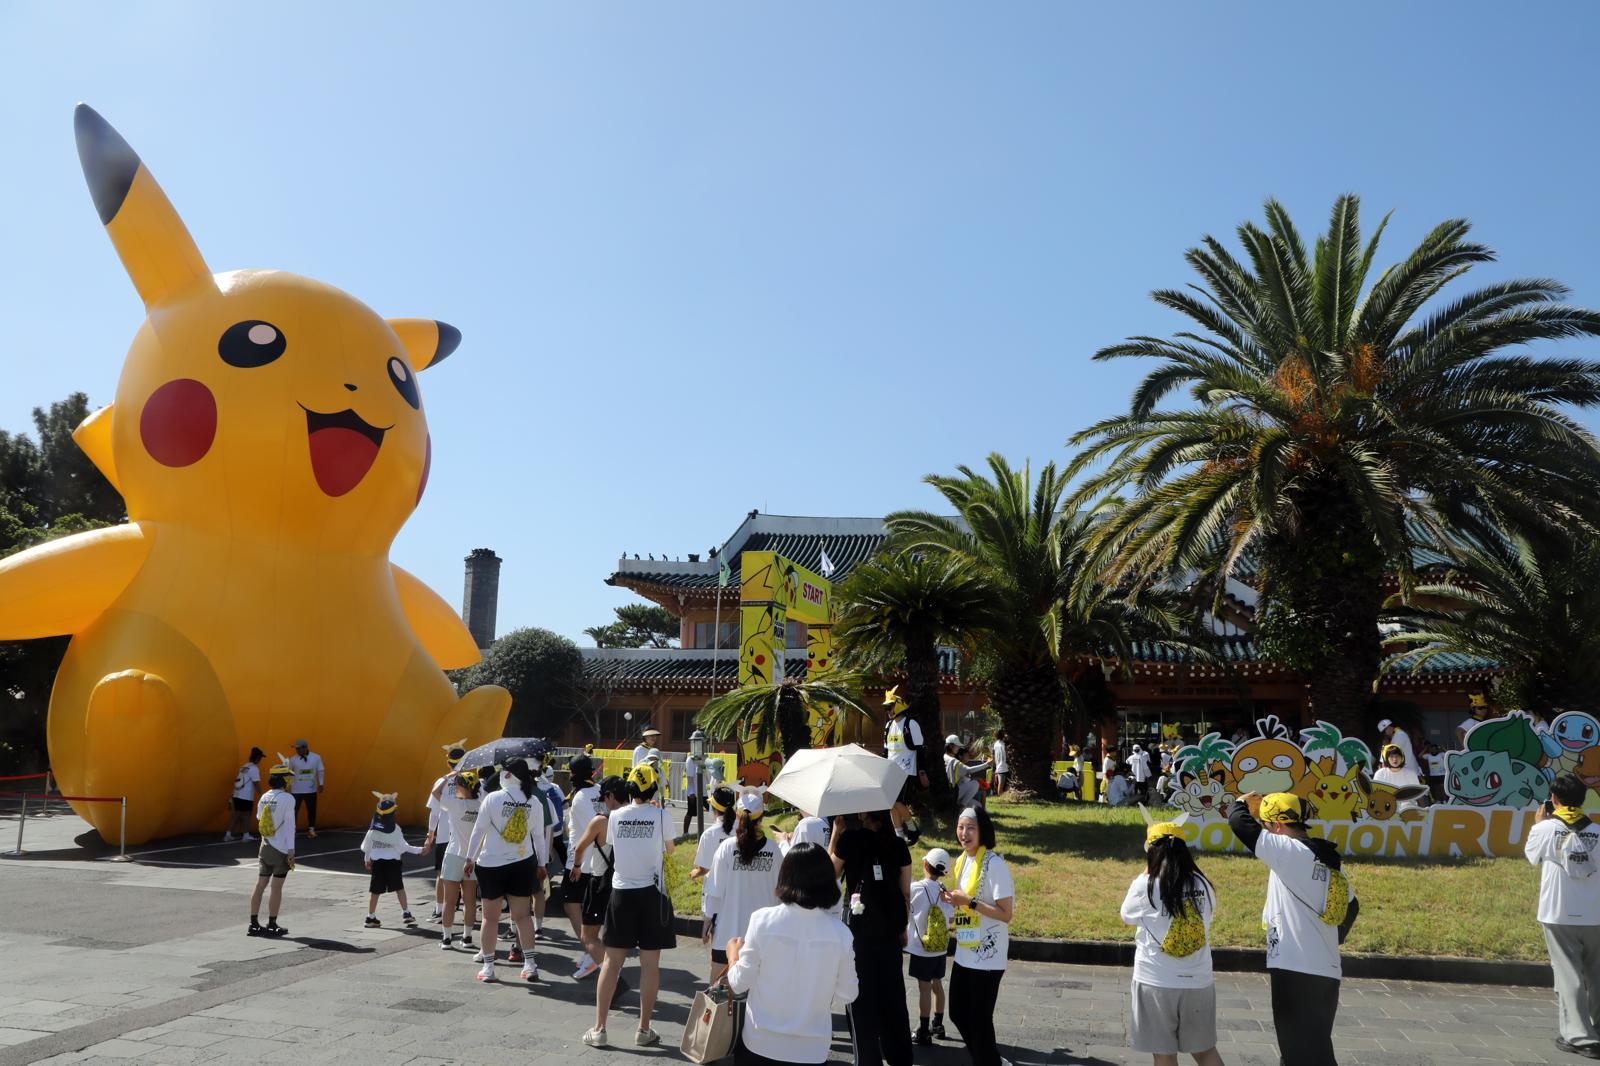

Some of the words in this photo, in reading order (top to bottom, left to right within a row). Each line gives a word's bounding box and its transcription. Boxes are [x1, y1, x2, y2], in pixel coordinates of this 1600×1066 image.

[803, 582, 823, 605] START
[617, 826, 655, 839] RUN
[1429, 810, 1600, 857] RU
[955, 917, 971, 926] UN
